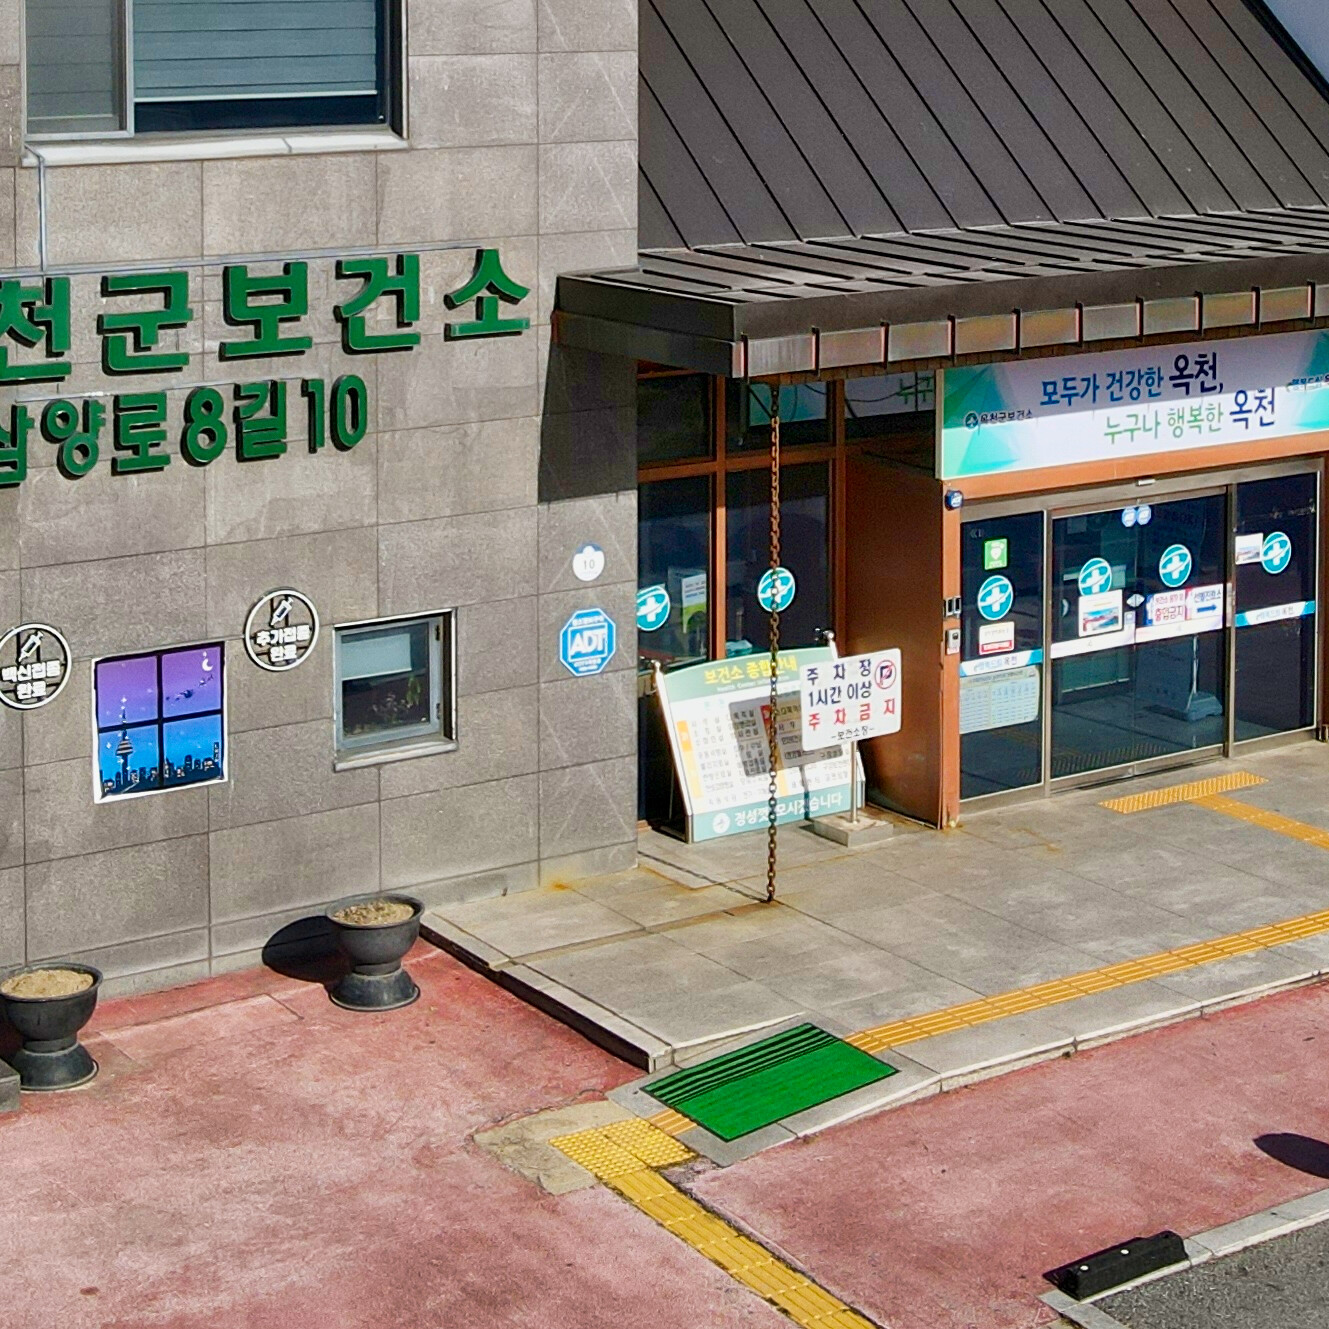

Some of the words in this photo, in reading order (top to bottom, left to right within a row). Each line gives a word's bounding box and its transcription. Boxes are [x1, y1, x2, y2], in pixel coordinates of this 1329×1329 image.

[1039, 370, 1099, 407] 모두가
[1105, 366, 1164, 403] 건강한
[1168, 351, 1224, 394] 옥천,
[980, 409, 1032, 424] 옥천군보건소
[1104, 411, 1162, 445] 누구나
[1167, 403, 1224, 439] 행복한
[1228, 387, 1276, 430] 옥천
[583, 559, 595, 570] 10
[256, 625, 310, 646] 추가접종
[570, 629, 605, 656] ADT
[270, 644, 297, 662] 완료
[1, 660, 60, 682] 백신접종
[705, 665, 745, 684] 보건소
[17, 681, 46, 700] 완료
[808, 686, 842, 707] 1시간
[847, 680, 872, 700] 이상
